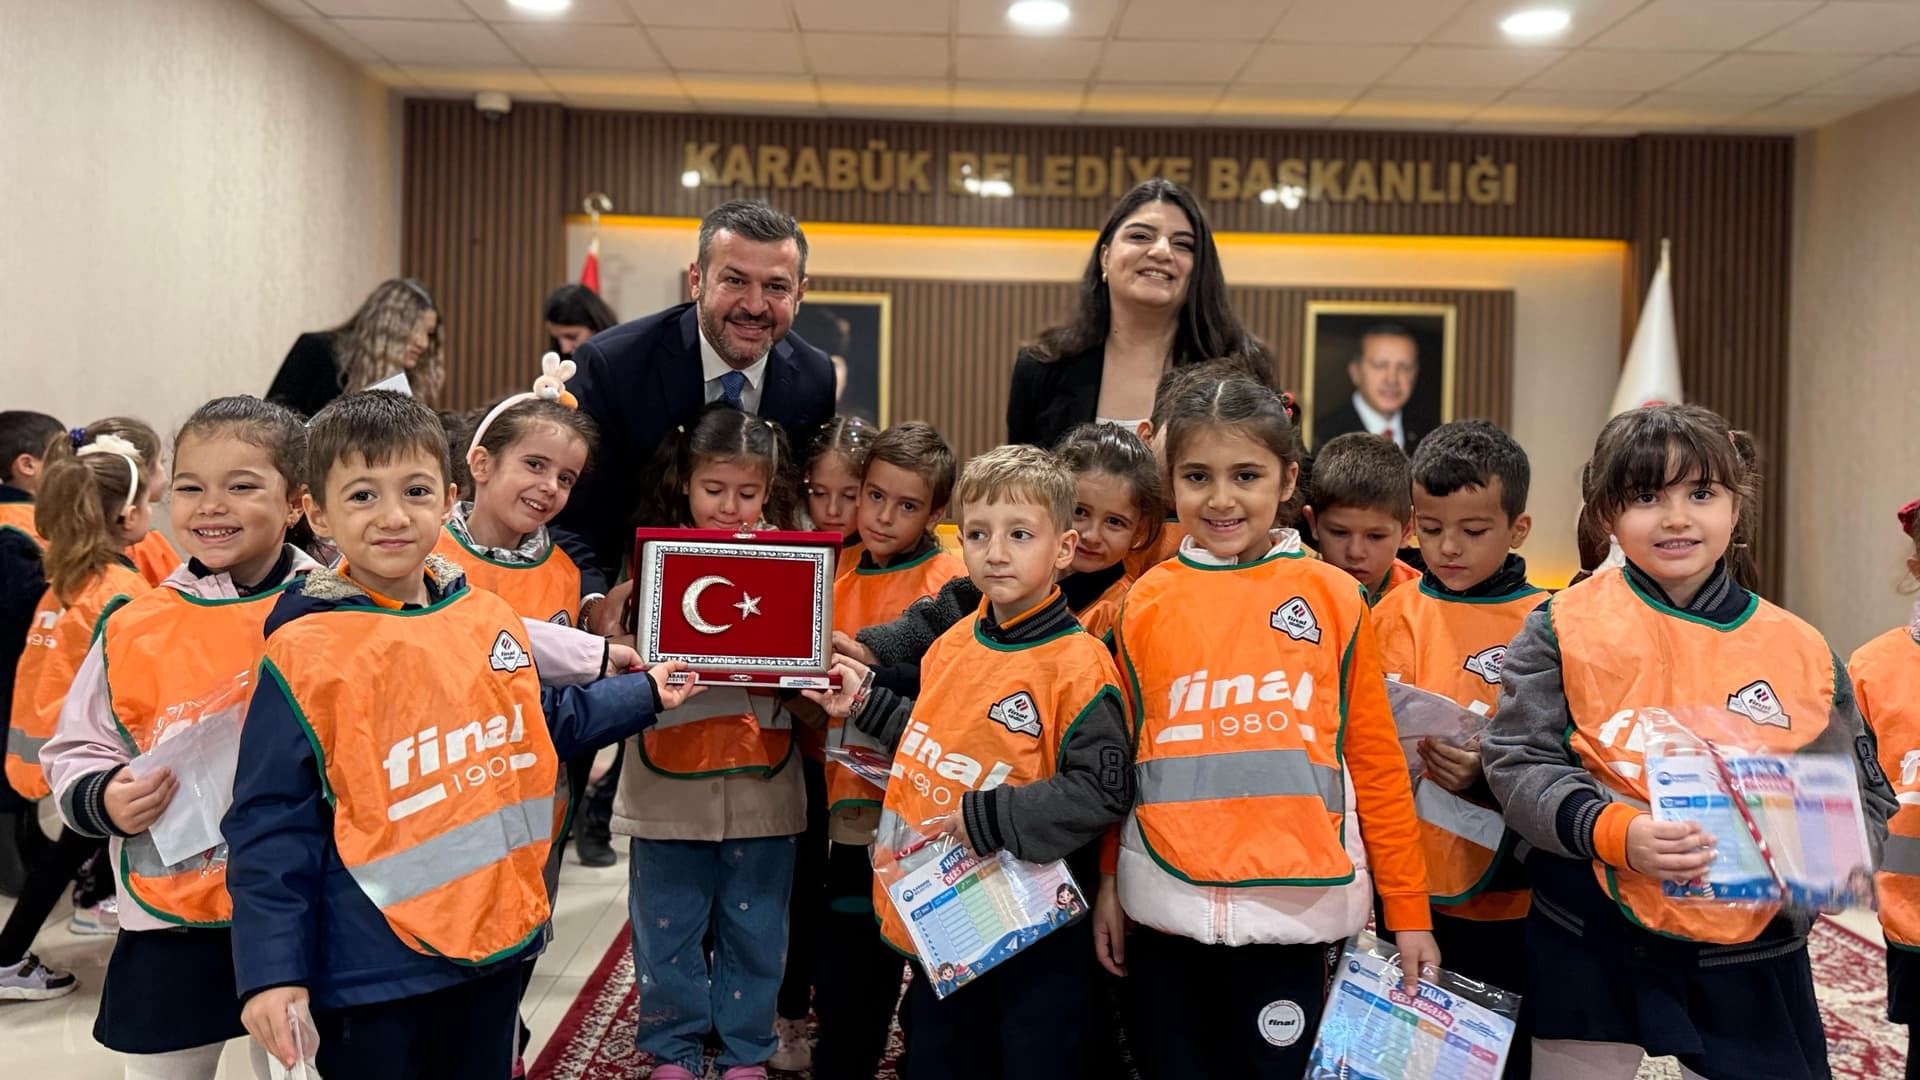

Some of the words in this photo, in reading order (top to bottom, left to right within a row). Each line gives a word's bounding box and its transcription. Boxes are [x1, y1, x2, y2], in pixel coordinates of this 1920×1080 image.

[684, 141, 931, 194] KARABÜK
[948, 146, 1193, 197] BELEDİYE
[1168, 670, 1313, 720] final
[383, 704, 524, 791] final
[1211, 711, 1288, 738] 1980
[900, 718, 1014, 790] inal
[943, 846, 968, 870] HAFTA
